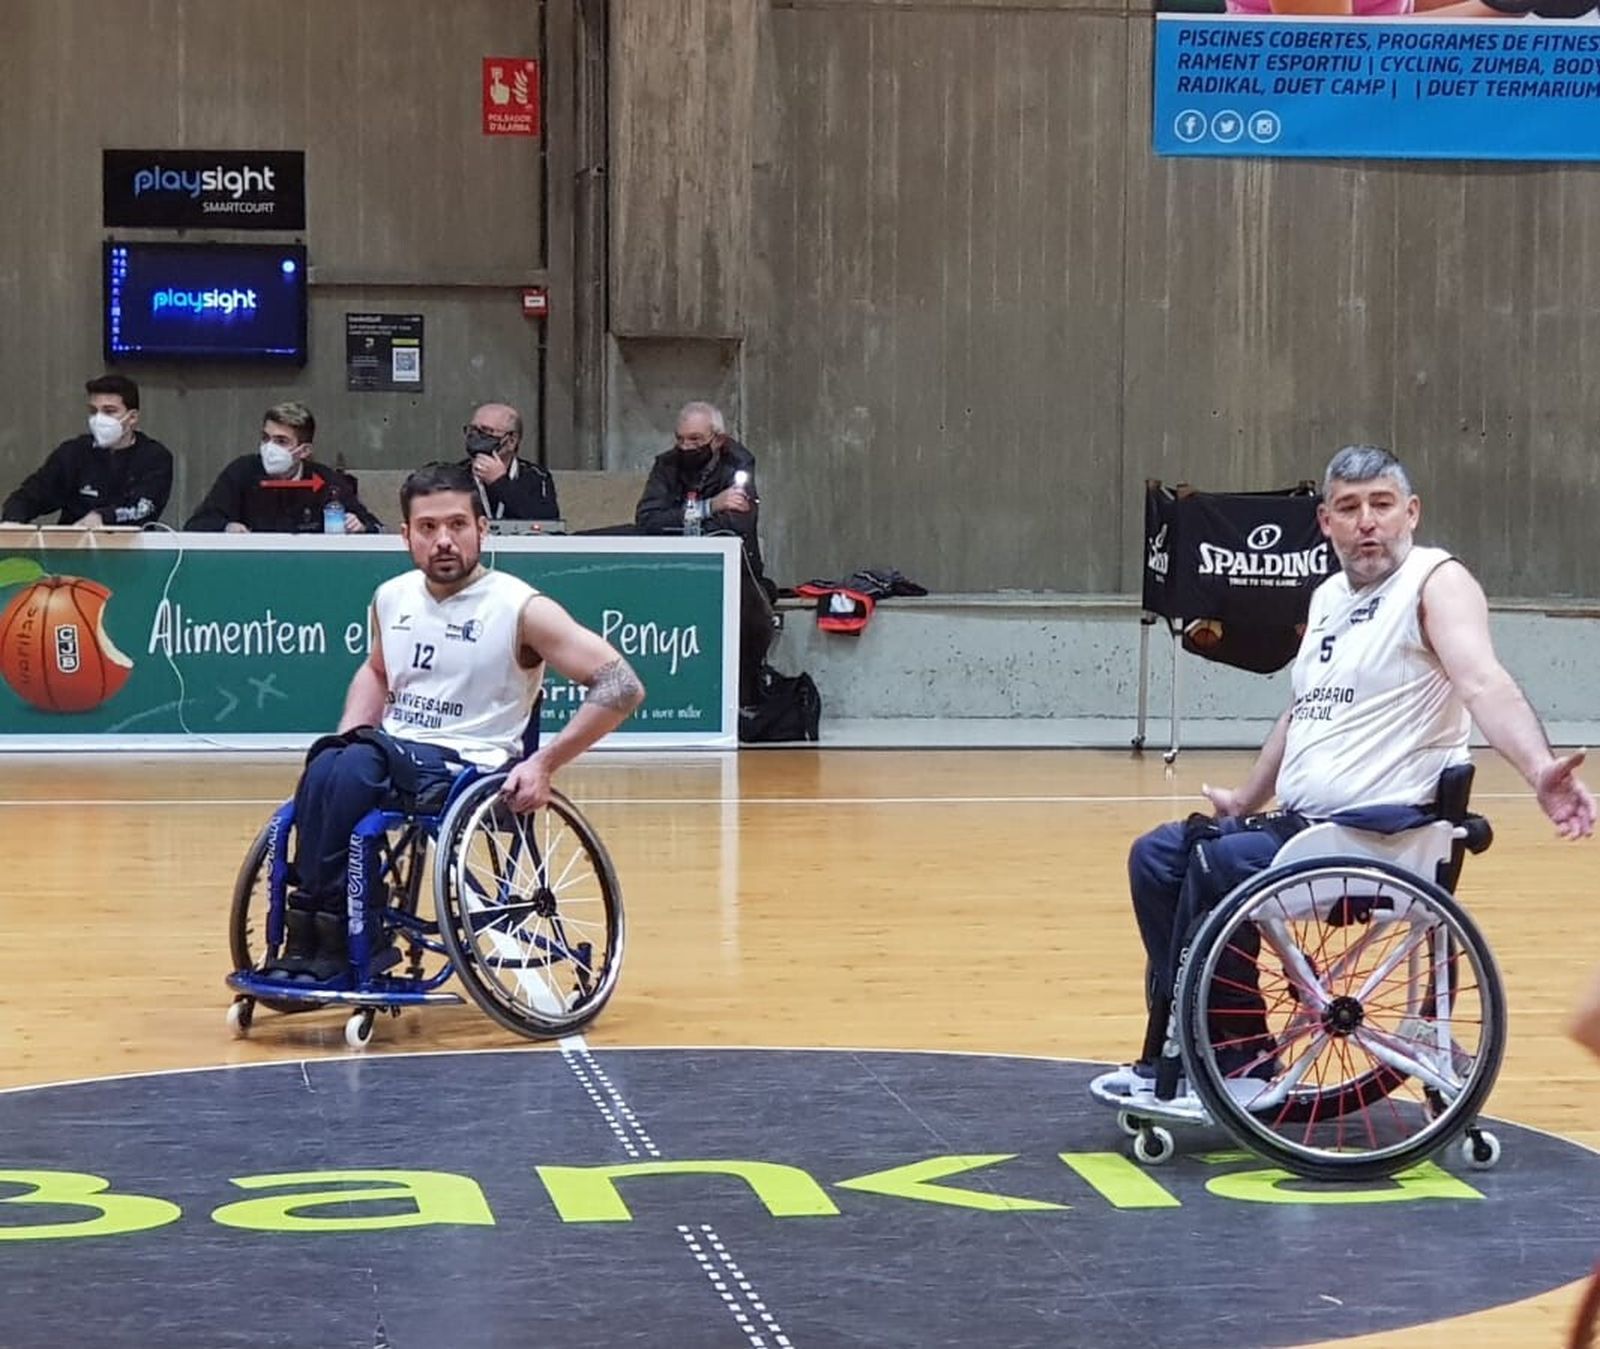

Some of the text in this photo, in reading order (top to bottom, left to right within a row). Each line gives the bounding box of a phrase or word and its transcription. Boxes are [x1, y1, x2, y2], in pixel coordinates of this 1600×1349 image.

[1178, 29, 1265, 48] PISCINES
[1269, 31, 1371, 51] COBERTES,
[1377, 33, 1498, 51] PROGRAMES
[1502, 35, 1529, 50] DE
[1177, 53, 1260, 71] RAMENT
[1266, 54, 1362, 72] ESPORTIU
[1380, 56, 1463, 75] CYCLING,
[1470, 57, 1544, 76] ZUMBA,
[1177, 76, 1266, 95] RADIKAL,
[1273, 77, 1325, 95] DUET
[1331, 78, 1385, 96] CAMP
[1427, 79, 1479, 97] DUET
[134, 165, 276, 199] playsight
[203, 201, 275, 213] SMARTCOURT
[153, 287, 257, 315] playsight
[1198, 542, 1328, 577] SPALDING
[148, 598, 326, 656] Alimentem
[602, 609, 700, 675] Penya
[1320, 635, 1336, 663] 5
[412, 642, 435, 670] 12
